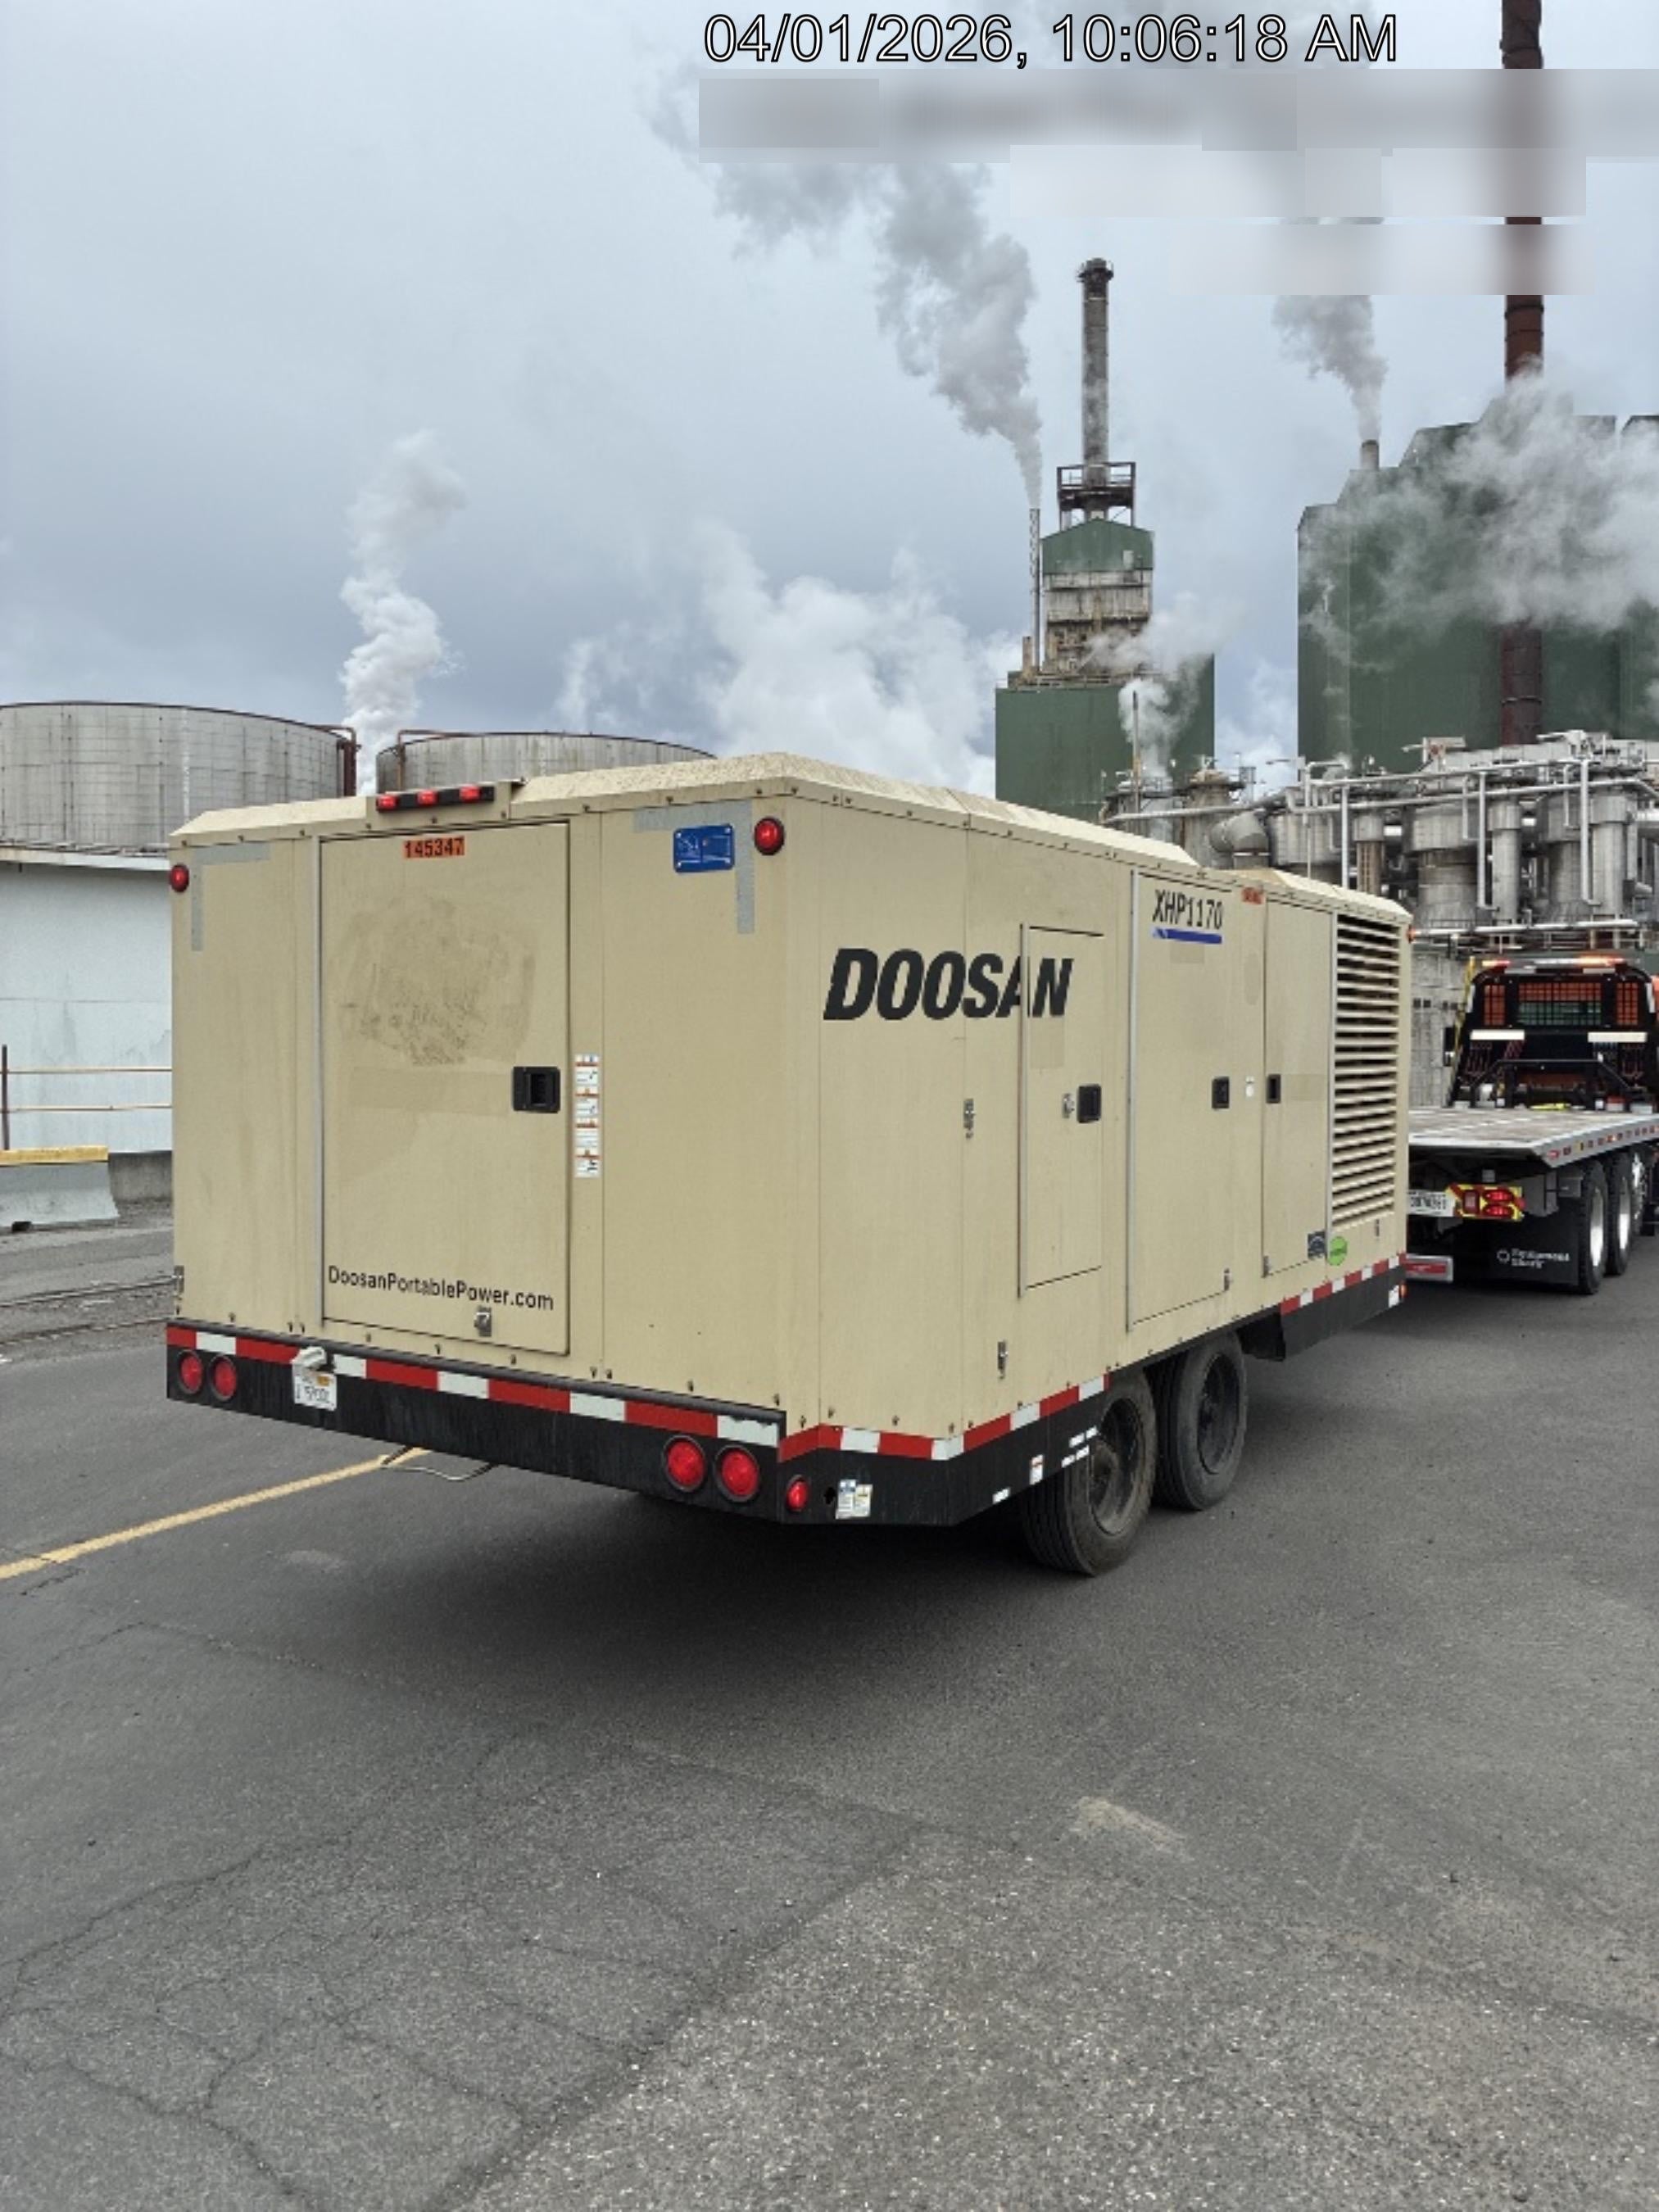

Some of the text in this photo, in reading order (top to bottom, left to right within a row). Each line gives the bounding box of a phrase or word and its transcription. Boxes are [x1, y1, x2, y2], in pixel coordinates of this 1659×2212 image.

[405, 836, 465, 858] 145347
[1152, 889, 1223, 930] XHP1170
[823, 948, 1074, 1020] DOOSAN
[328, 1265, 554, 1310] DoosanPortablePower.com
